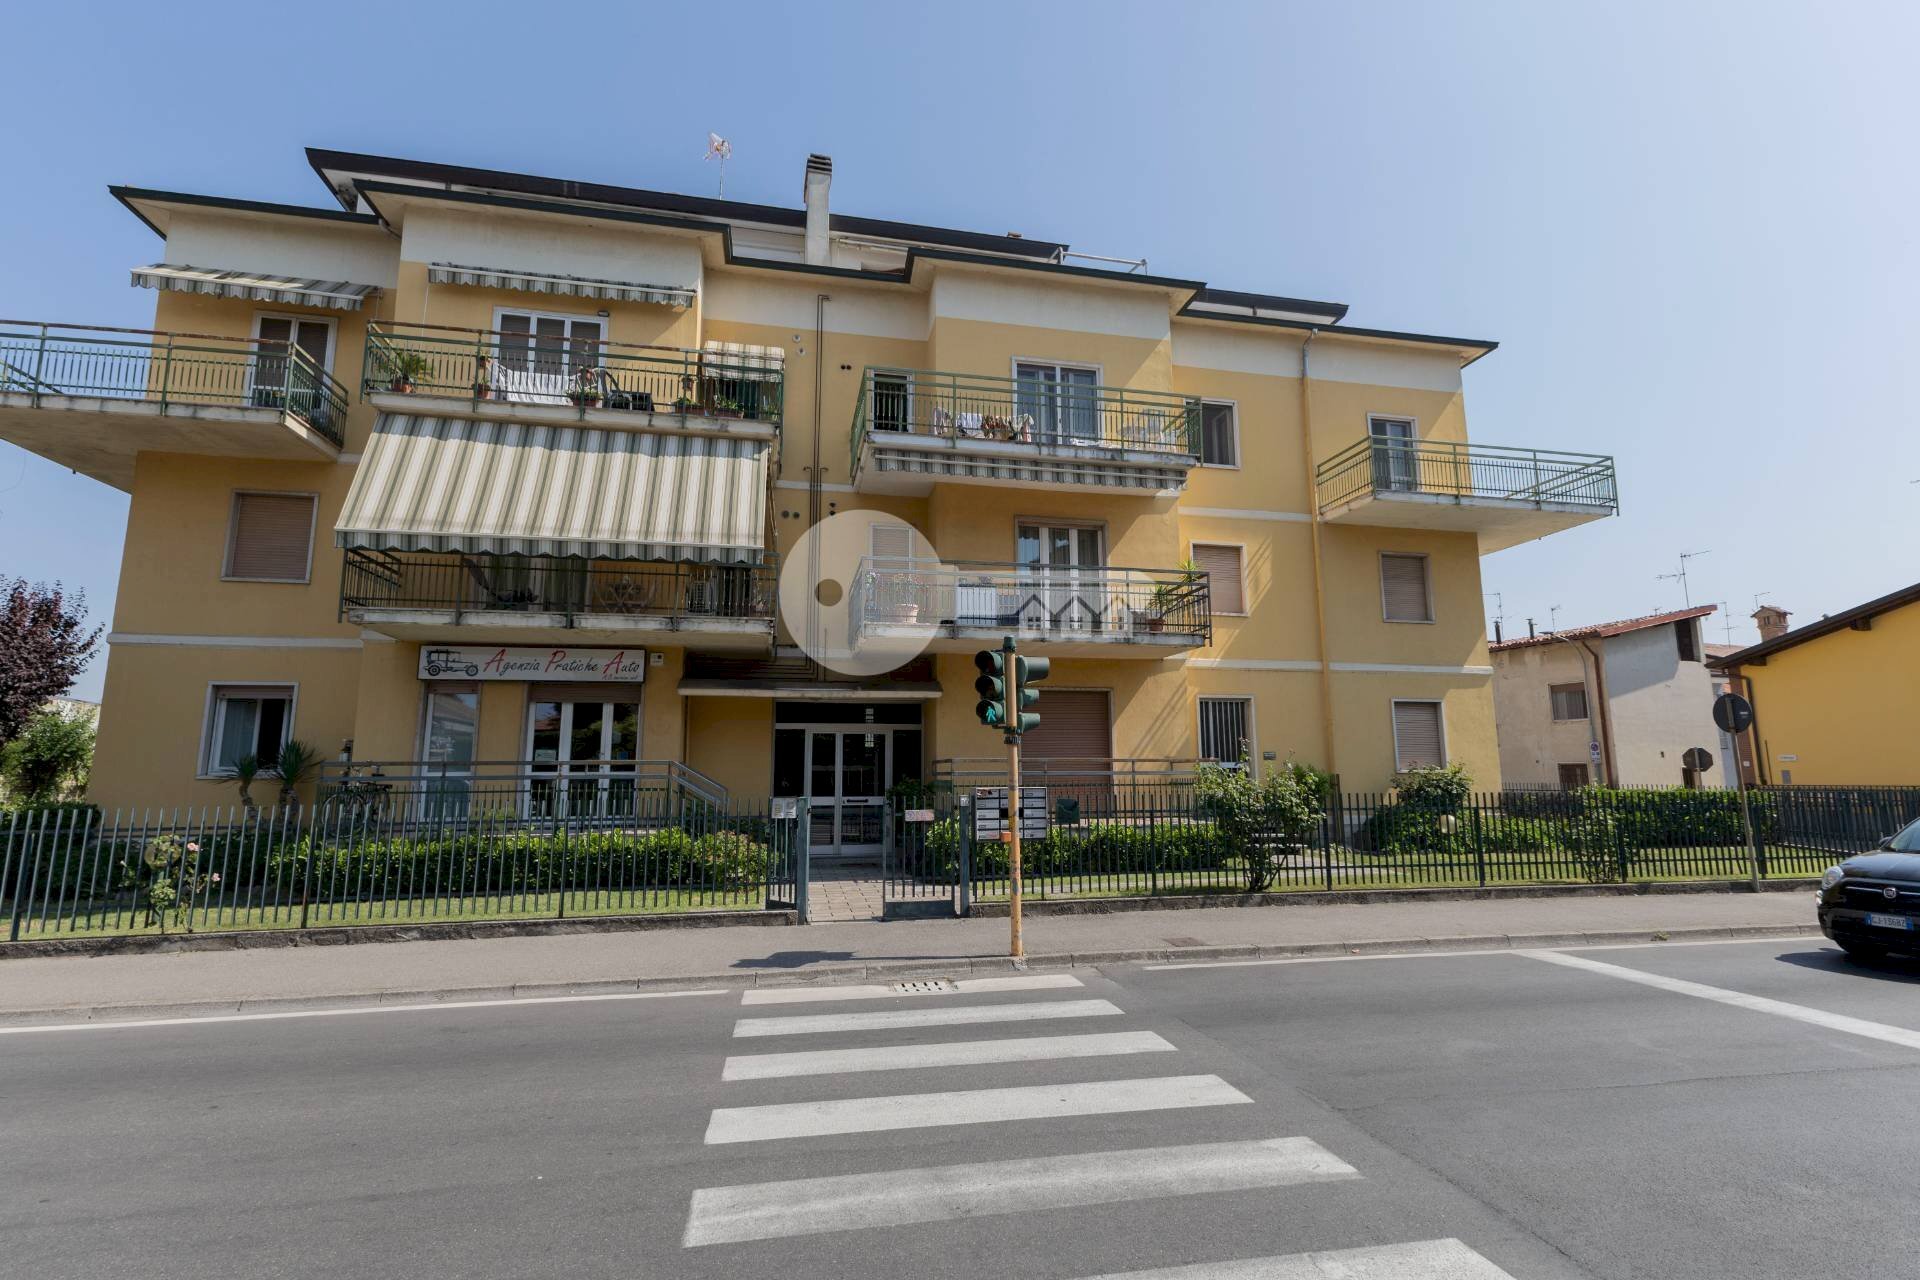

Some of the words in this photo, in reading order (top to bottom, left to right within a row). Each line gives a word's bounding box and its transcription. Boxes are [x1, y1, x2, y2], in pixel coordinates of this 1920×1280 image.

[483, 648, 540, 676] Agenzia
[544, 649, 599, 673] Pratiche
[602, 651, 640, 674] Auto
